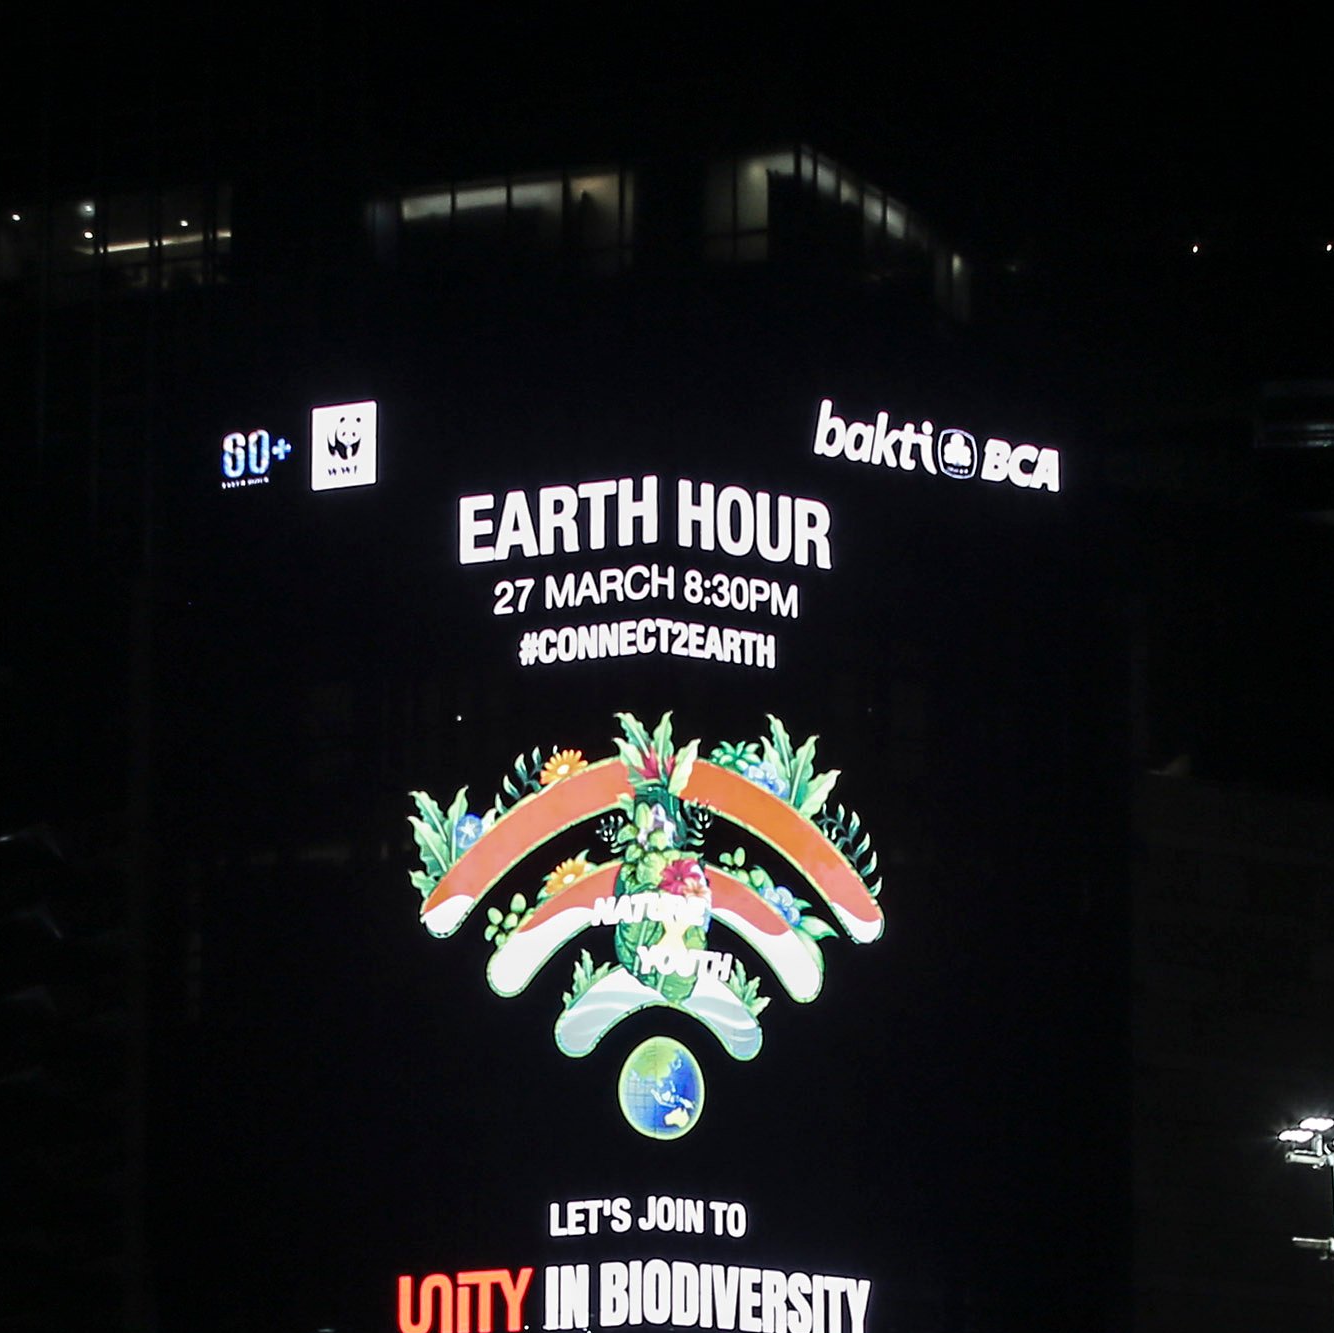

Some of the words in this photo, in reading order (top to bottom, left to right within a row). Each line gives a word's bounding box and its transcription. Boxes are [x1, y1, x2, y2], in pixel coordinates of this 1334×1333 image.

[222, 429, 291, 478] 60+
[814, 399, 937, 475] bakti
[980, 438, 1060, 493] BCA
[460, 475, 658, 564] EARTH
[677, 479, 832, 570] HOUR
[493, 578, 536, 615] 27
[545, 564, 674, 609] MARCH
[683, 569, 799, 618] 8:30PM
[518, 618, 776, 669] #CONNECT2EARTH
[637, 945, 733, 982] YOUTH
[550, 1198, 631, 1237] LET'S
[638, 1196, 704, 1234] JOIN
[709, 1201, 746, 1238] TO
[544, 1264, 589, 1330] IN
